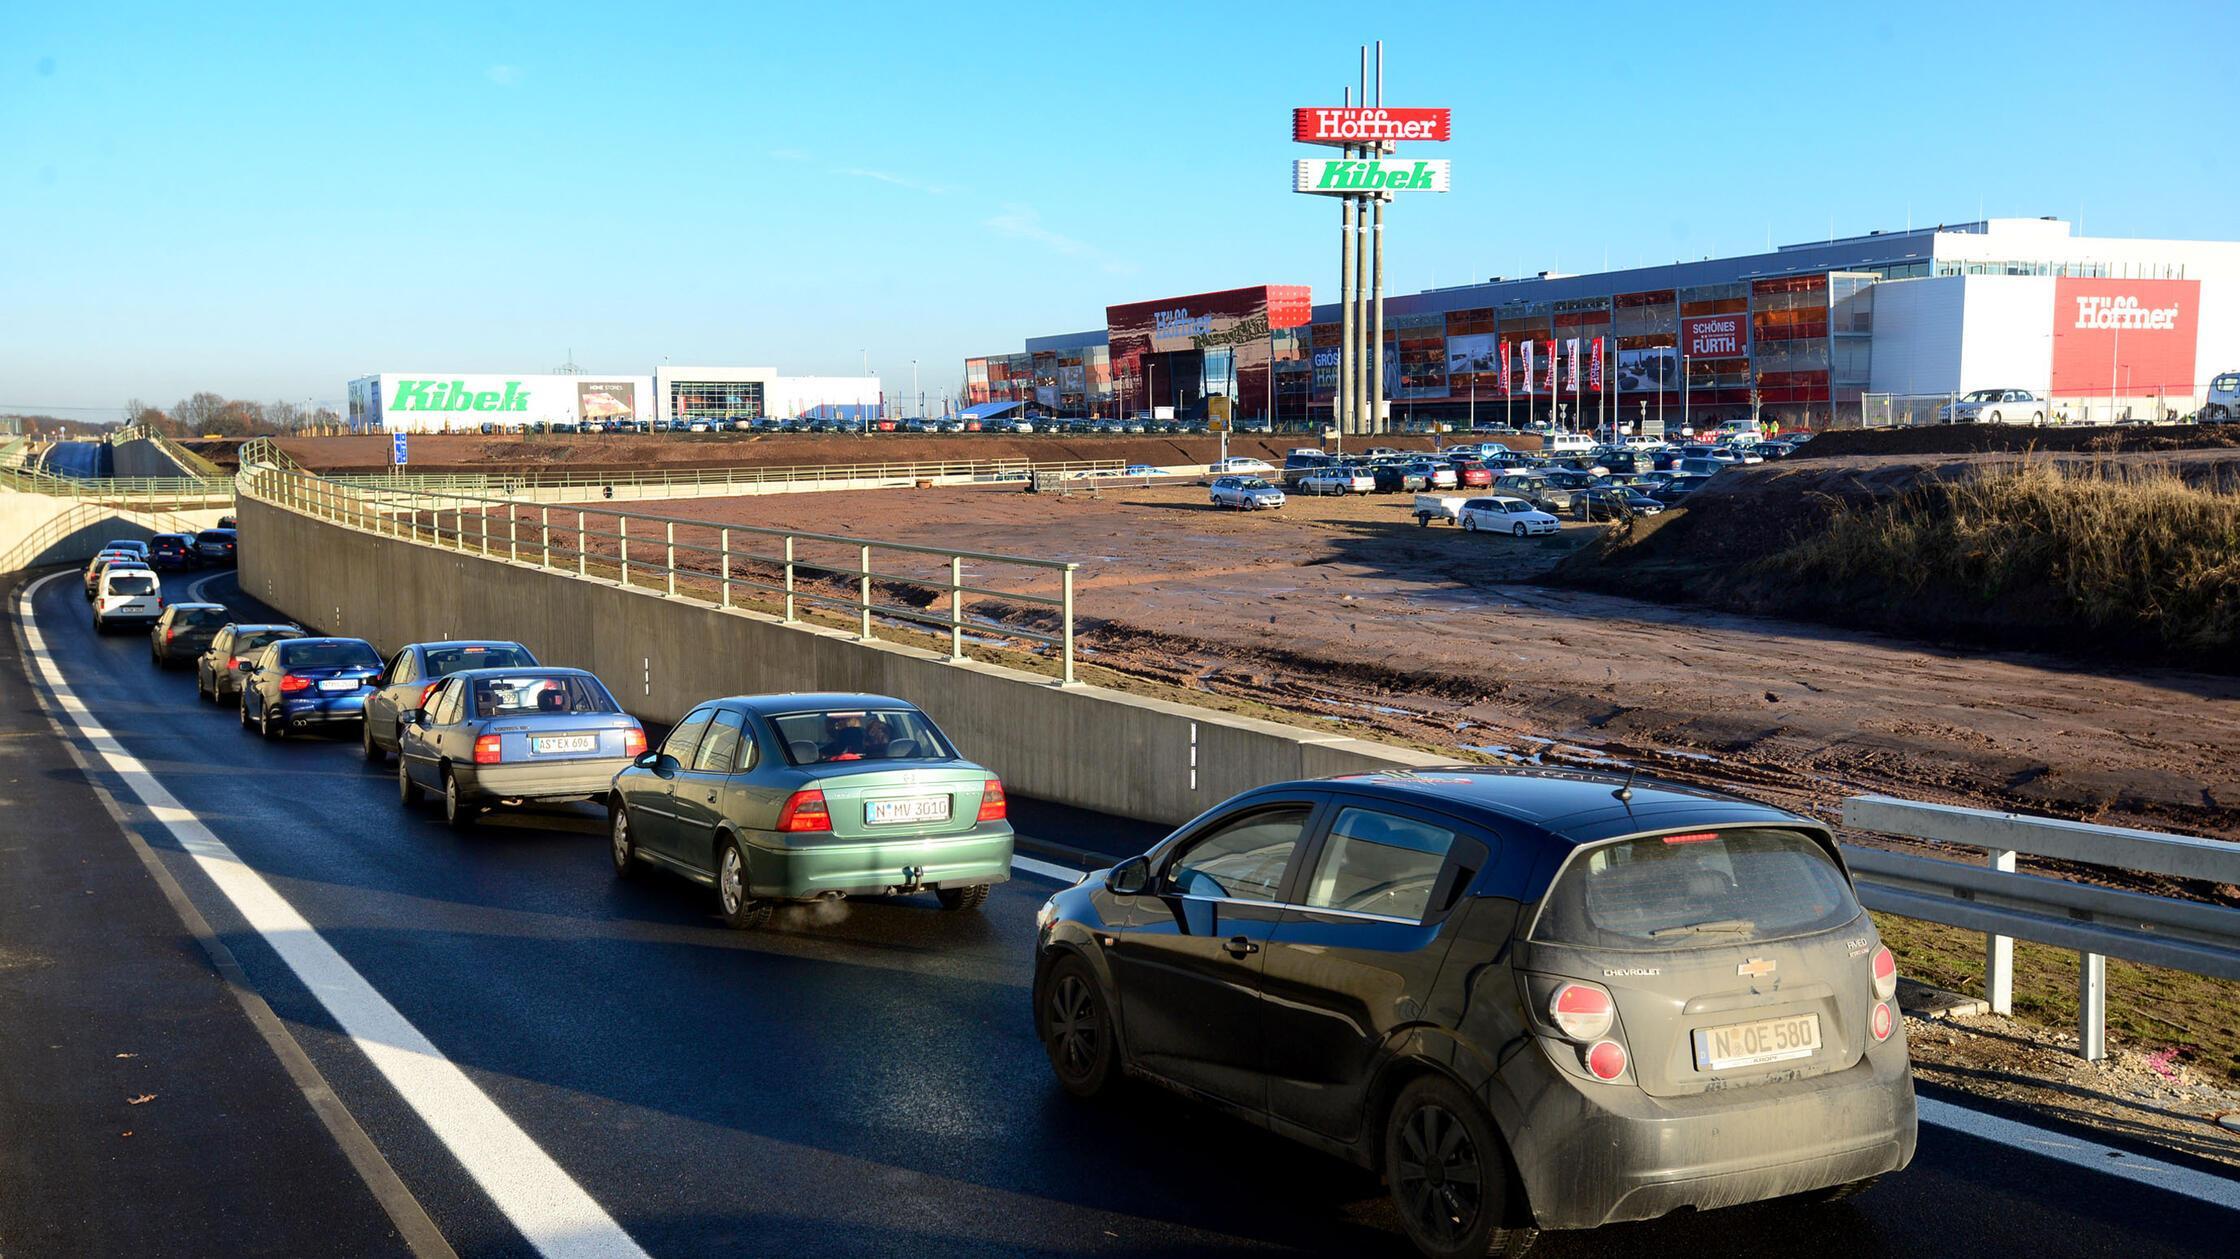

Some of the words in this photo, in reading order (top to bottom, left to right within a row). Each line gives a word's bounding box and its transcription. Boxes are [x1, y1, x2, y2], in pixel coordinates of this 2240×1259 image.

[1315, 109, 1437, 139] Höffner
[1316, 161, 1436, 189] Kibek
[2075, 296, 2178, 330] Höffner
[1692, 320, 1736, 334] SCHÖNES
[1693, 334, 1736, 354] FÜRTH
[388, 380, 532, 412] Kibek
[540, 740, 550, 749] AS
[557, 739, 569, 748] EX
[572, 738, 589, 747] 696
[876, 804, 886, 817] N
[894, 803, 911, 816] MV
[915, 801, 947, 816] 3010
[1602, 968, 1661, 977] CHEVROLET
[1715, 1030, 1731, 1059] N
[1744, 1026, 1773, 1055] OE
[1775, 1020, 1813, 1050] 580
